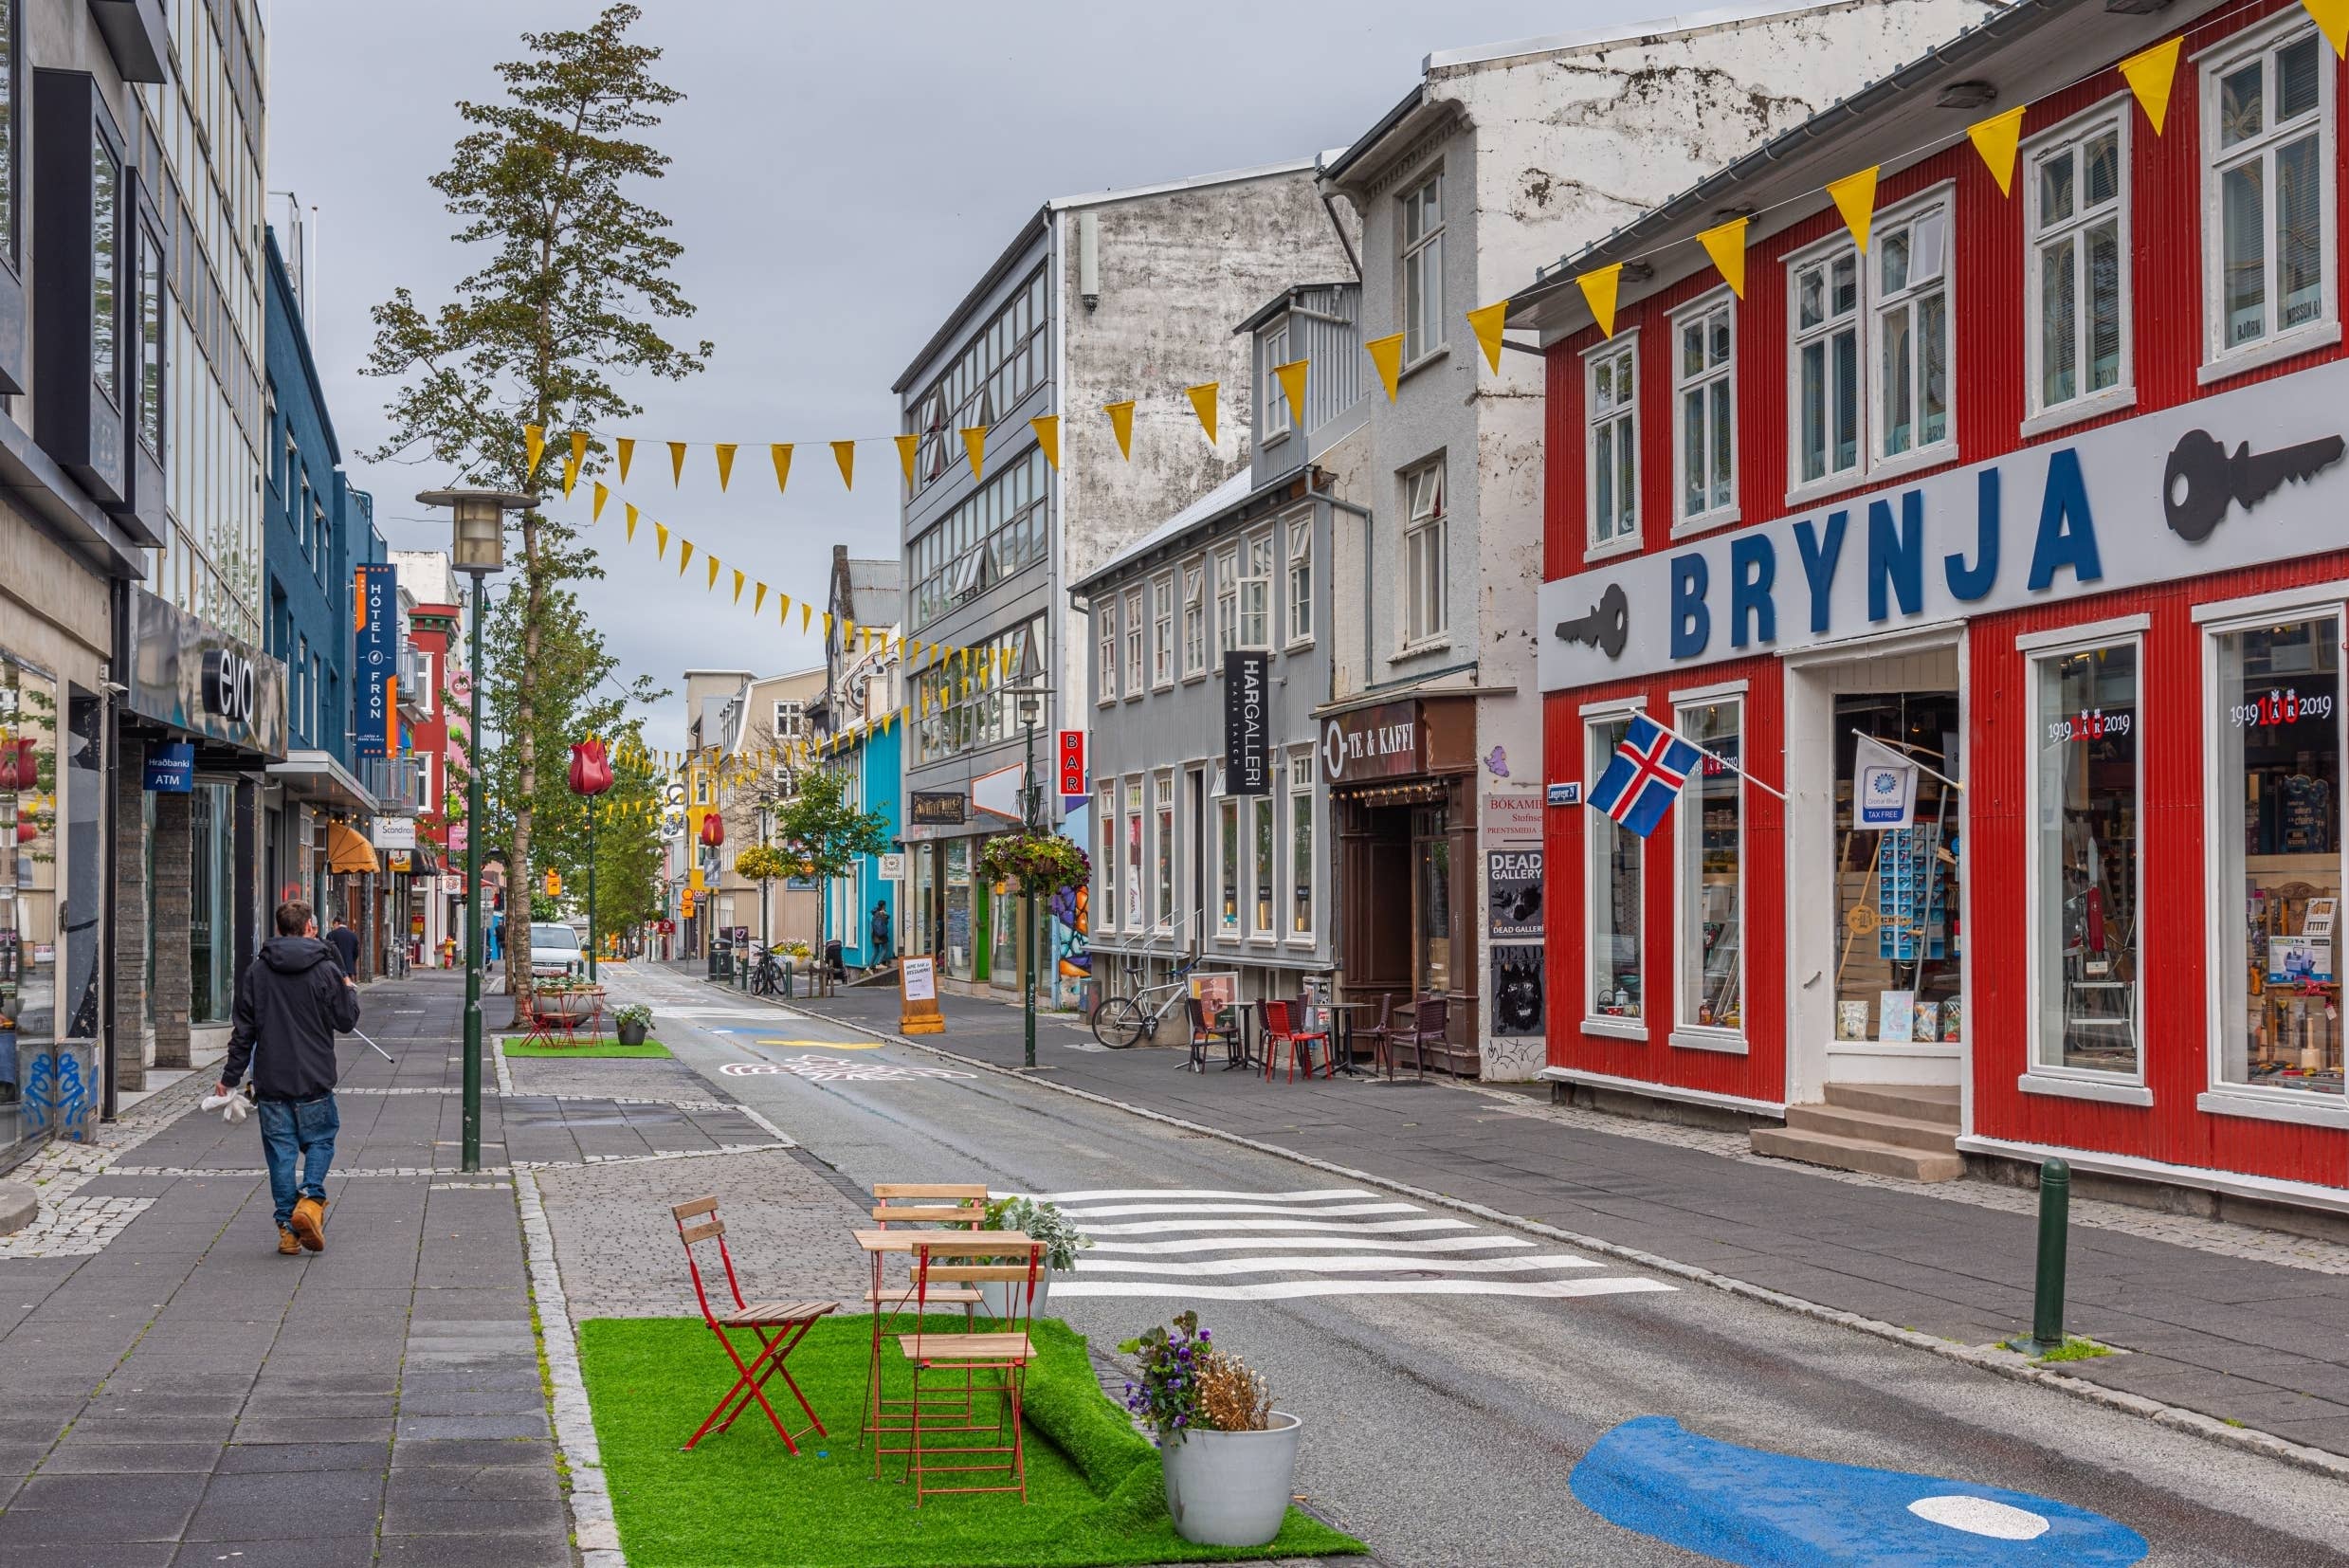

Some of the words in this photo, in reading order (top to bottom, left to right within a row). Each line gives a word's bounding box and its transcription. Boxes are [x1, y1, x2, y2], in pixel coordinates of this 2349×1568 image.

[1670, 447, 2103, 660] BRYNJA
[370, 584, 381, 643] HÓTEL
[219, 648, 254, 723] eva
[370, 671, 381, 719] FRÓN
[2231, 703, 2259, 728] 1919
[2300, 695, 2332, 720] 2019
[1348, 732, 1363, 759] TE
[1367, 729, 1375, 757] &
[1378, 722, 1414, 755] KAFFI
[2049, 721, 2071, 743] 1919
[2104, 714, 2130, 736] 2019
[149, 758, 190, 769] Hraðbanki
[1065, 735, 1078, 792] BAR
[155, 775, 180, 786] ATM
[1867, 811, 1881, 819] TAX
[1881, 811, 1899, 819] FREE
[1491, 854, 1542, 870] DEAD
[1491, 868, 1542, 881] GALLERY
[1493, 946, 1543, 960] DEAD
